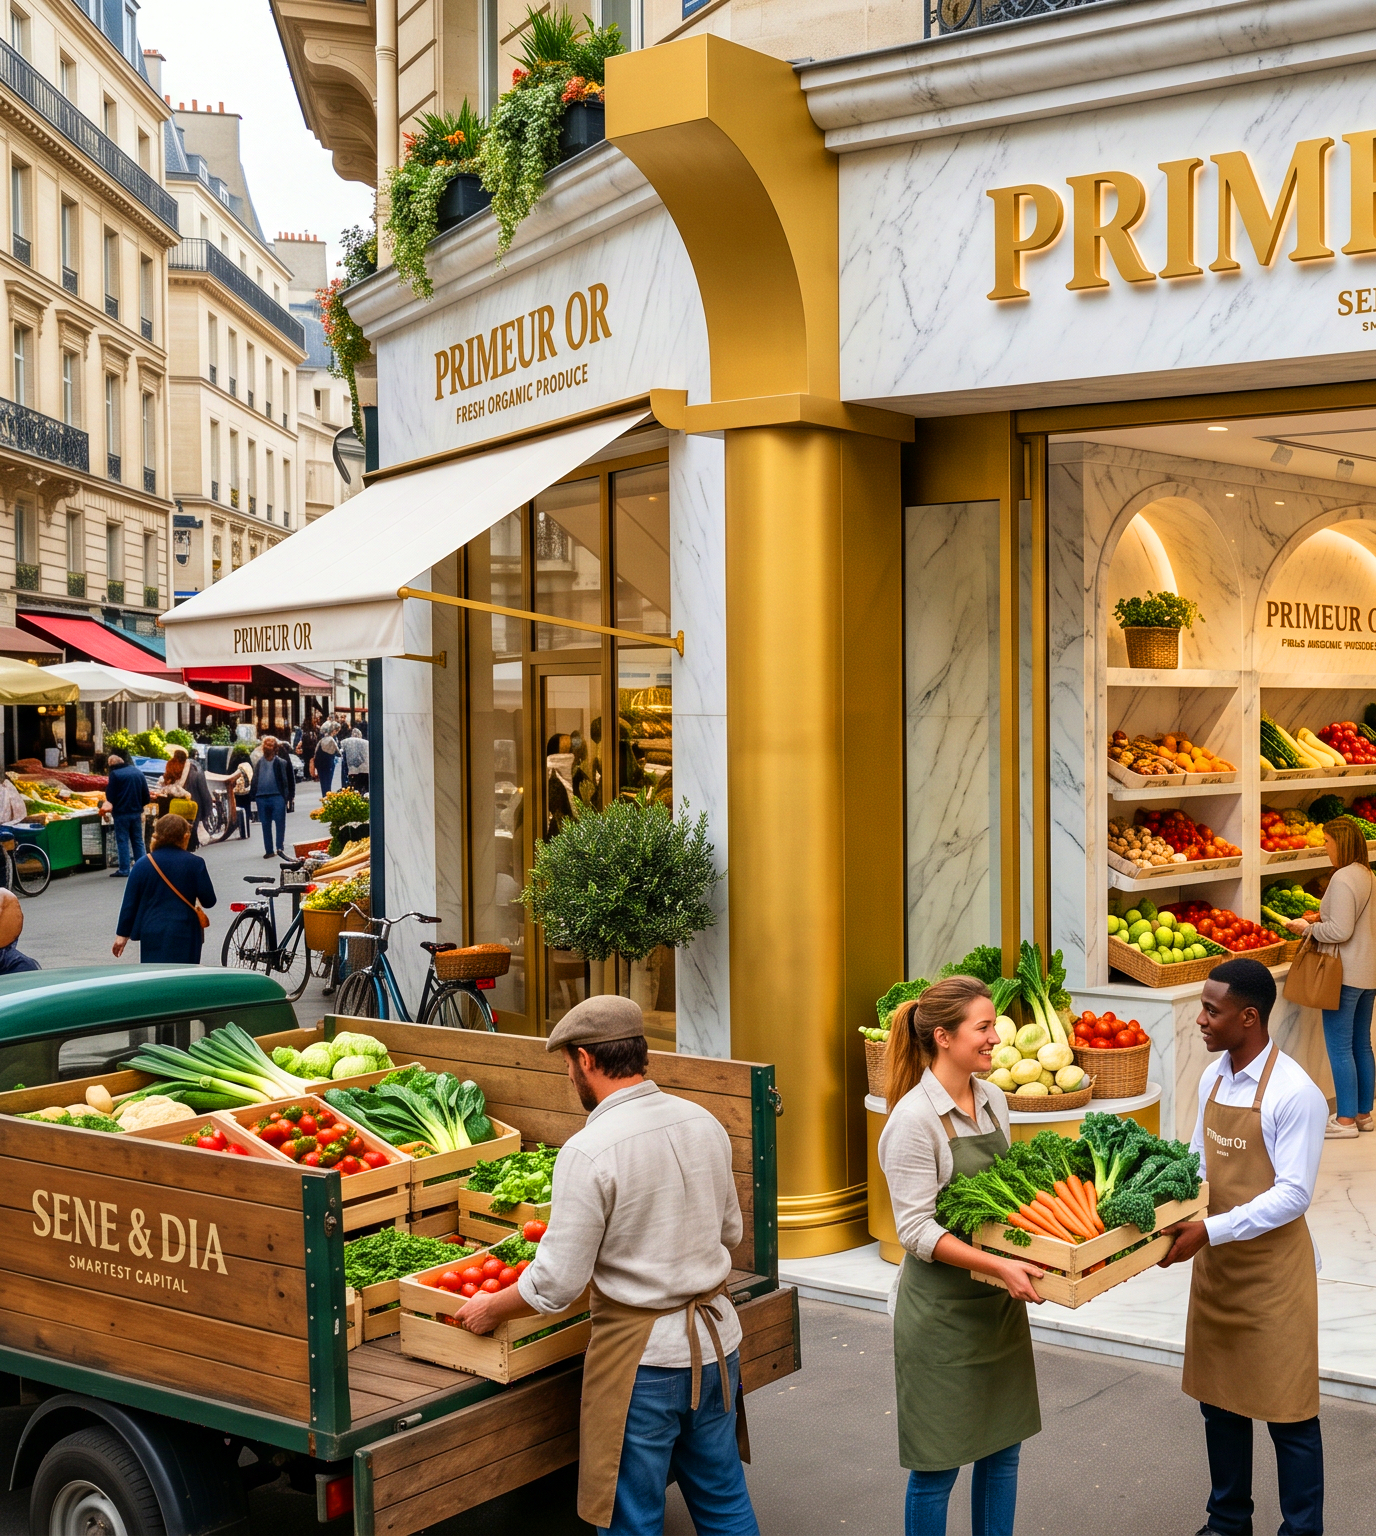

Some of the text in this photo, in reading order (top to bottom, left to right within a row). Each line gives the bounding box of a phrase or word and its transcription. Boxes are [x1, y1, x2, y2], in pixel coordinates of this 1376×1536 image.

[434, 282, 612, 401] PRIMEUR OR
[456, 363, 588, 424] FRESH ORGANIC PRODUCE
[233, 622, 313, 654] PRIMEUR OR
[1266, 600, 1363, 632] PRIMEUR
[32, 1189, 229, 1276] SENE & DIA
[69, 1254, 189, 1294] SMARTEST CAPITAL
